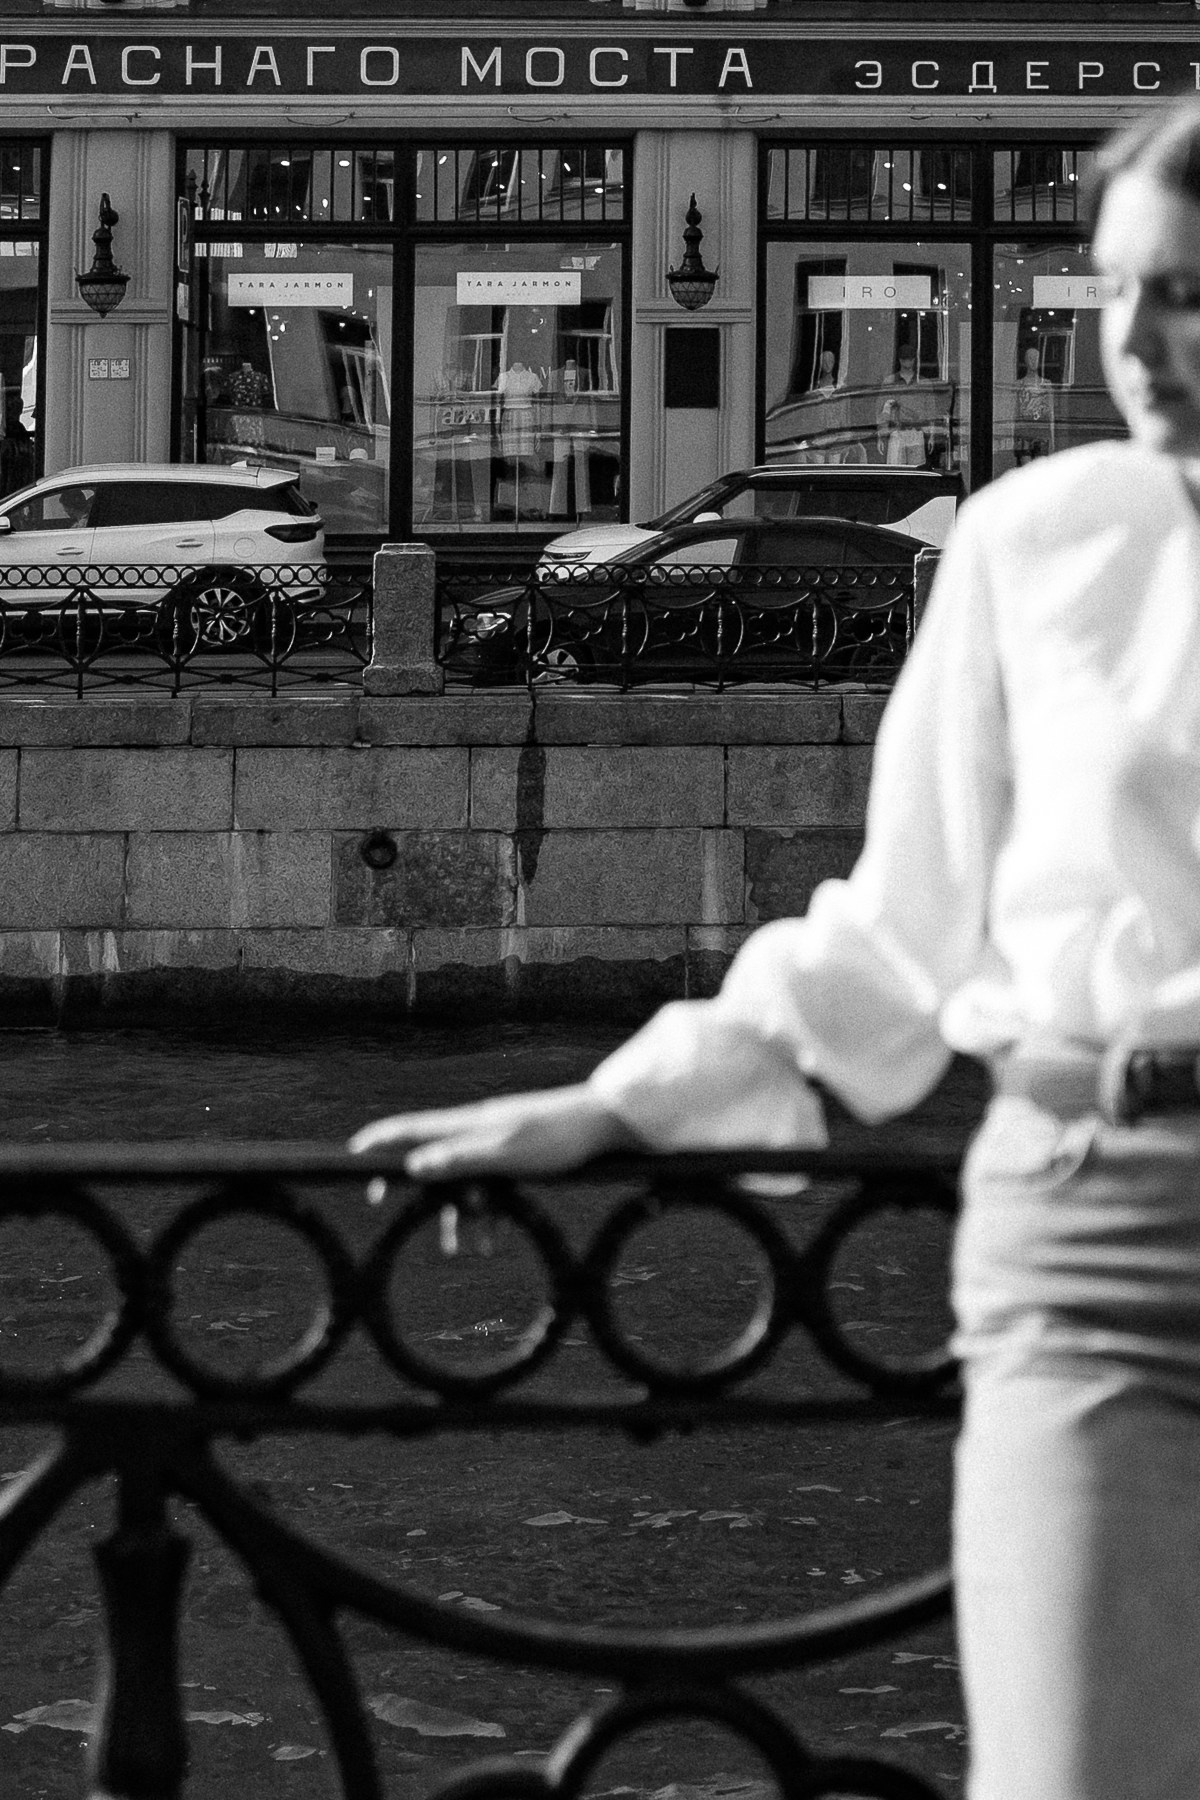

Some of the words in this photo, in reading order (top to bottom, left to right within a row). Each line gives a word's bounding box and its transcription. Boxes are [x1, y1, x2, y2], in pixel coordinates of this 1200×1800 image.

[461, 46, 753, 88] МОСТА
[238, 281, 276, 289] TARA
[284, 281, 345, 289] JARMON
[466, 280, 504, 288] TARA
[512, 280, 572, 288] JARMON
[841, 285, 897, 299] IRO
[1067, 286, 1098, 298] IR
